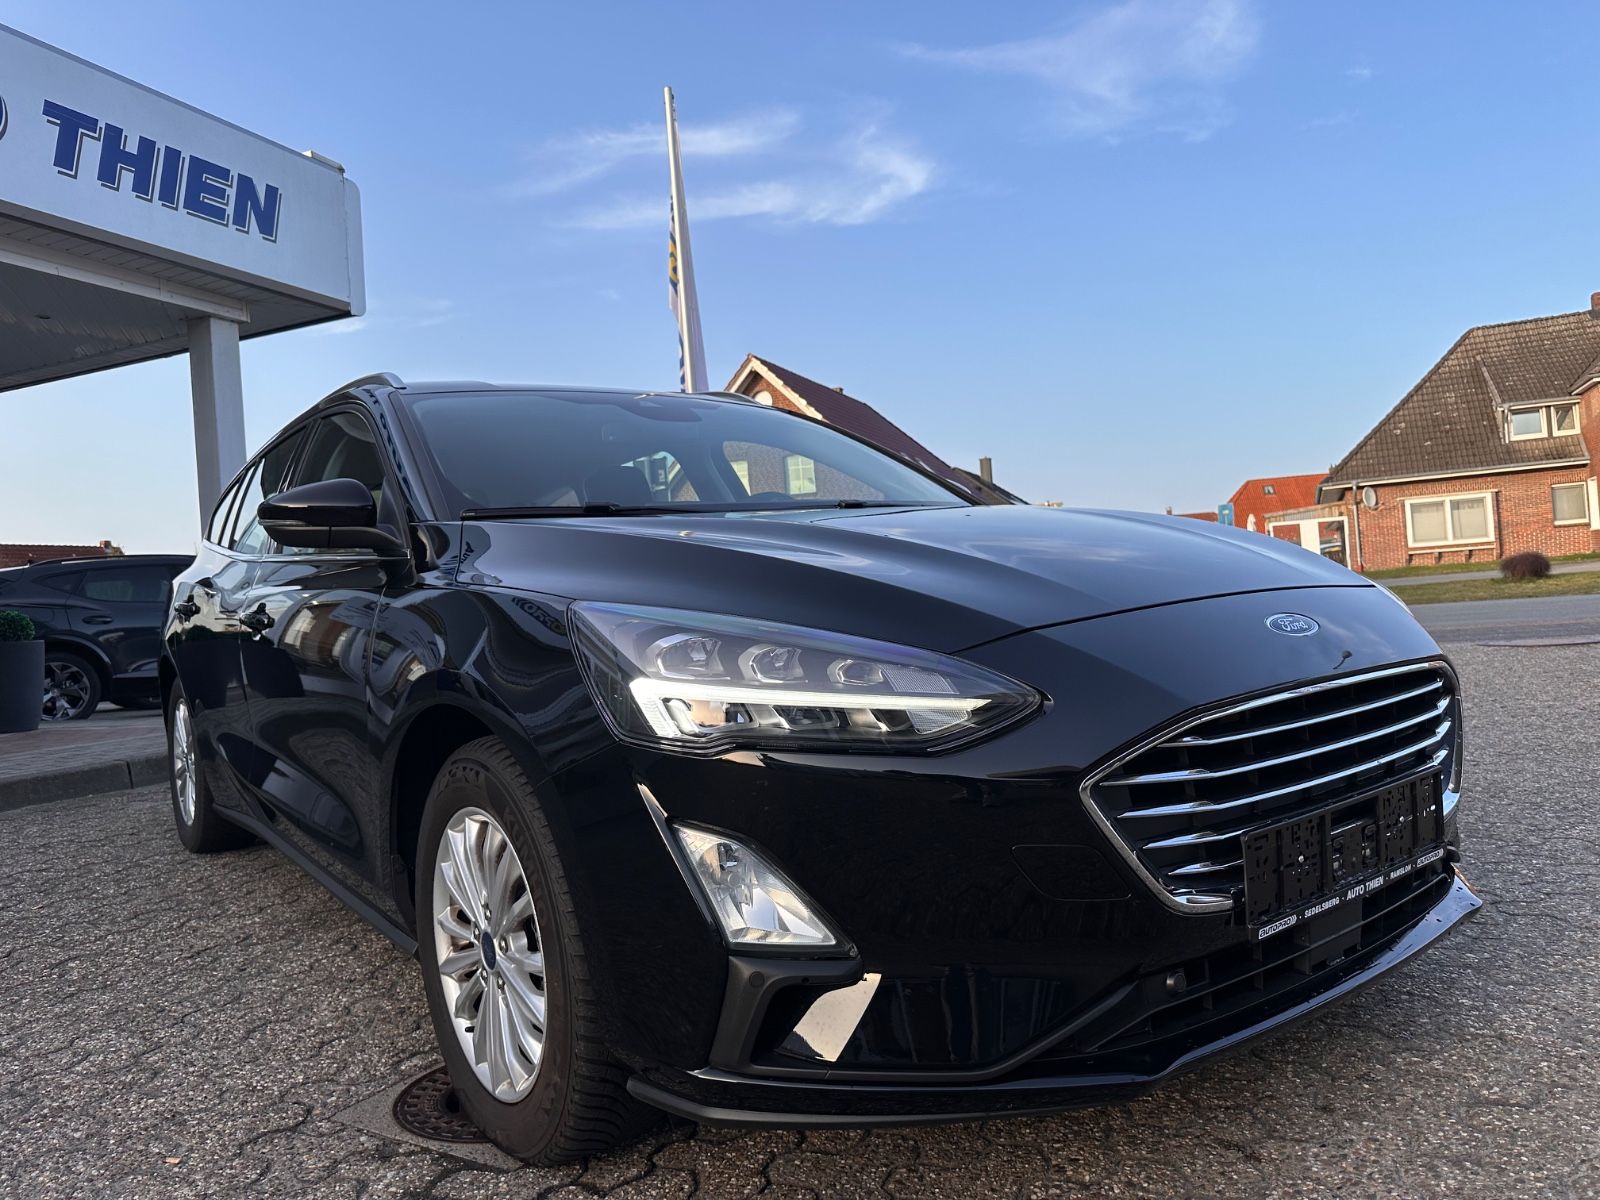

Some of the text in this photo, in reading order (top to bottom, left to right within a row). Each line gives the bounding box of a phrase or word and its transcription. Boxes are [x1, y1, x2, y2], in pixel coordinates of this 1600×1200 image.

[42, 99, 281, 242] THIEN
[1304, 897, 1340, 918] SEDELSBERG
[1347, 885, 1364, 900] AUTO
[1366, 876, 1384, 892] THIEN
